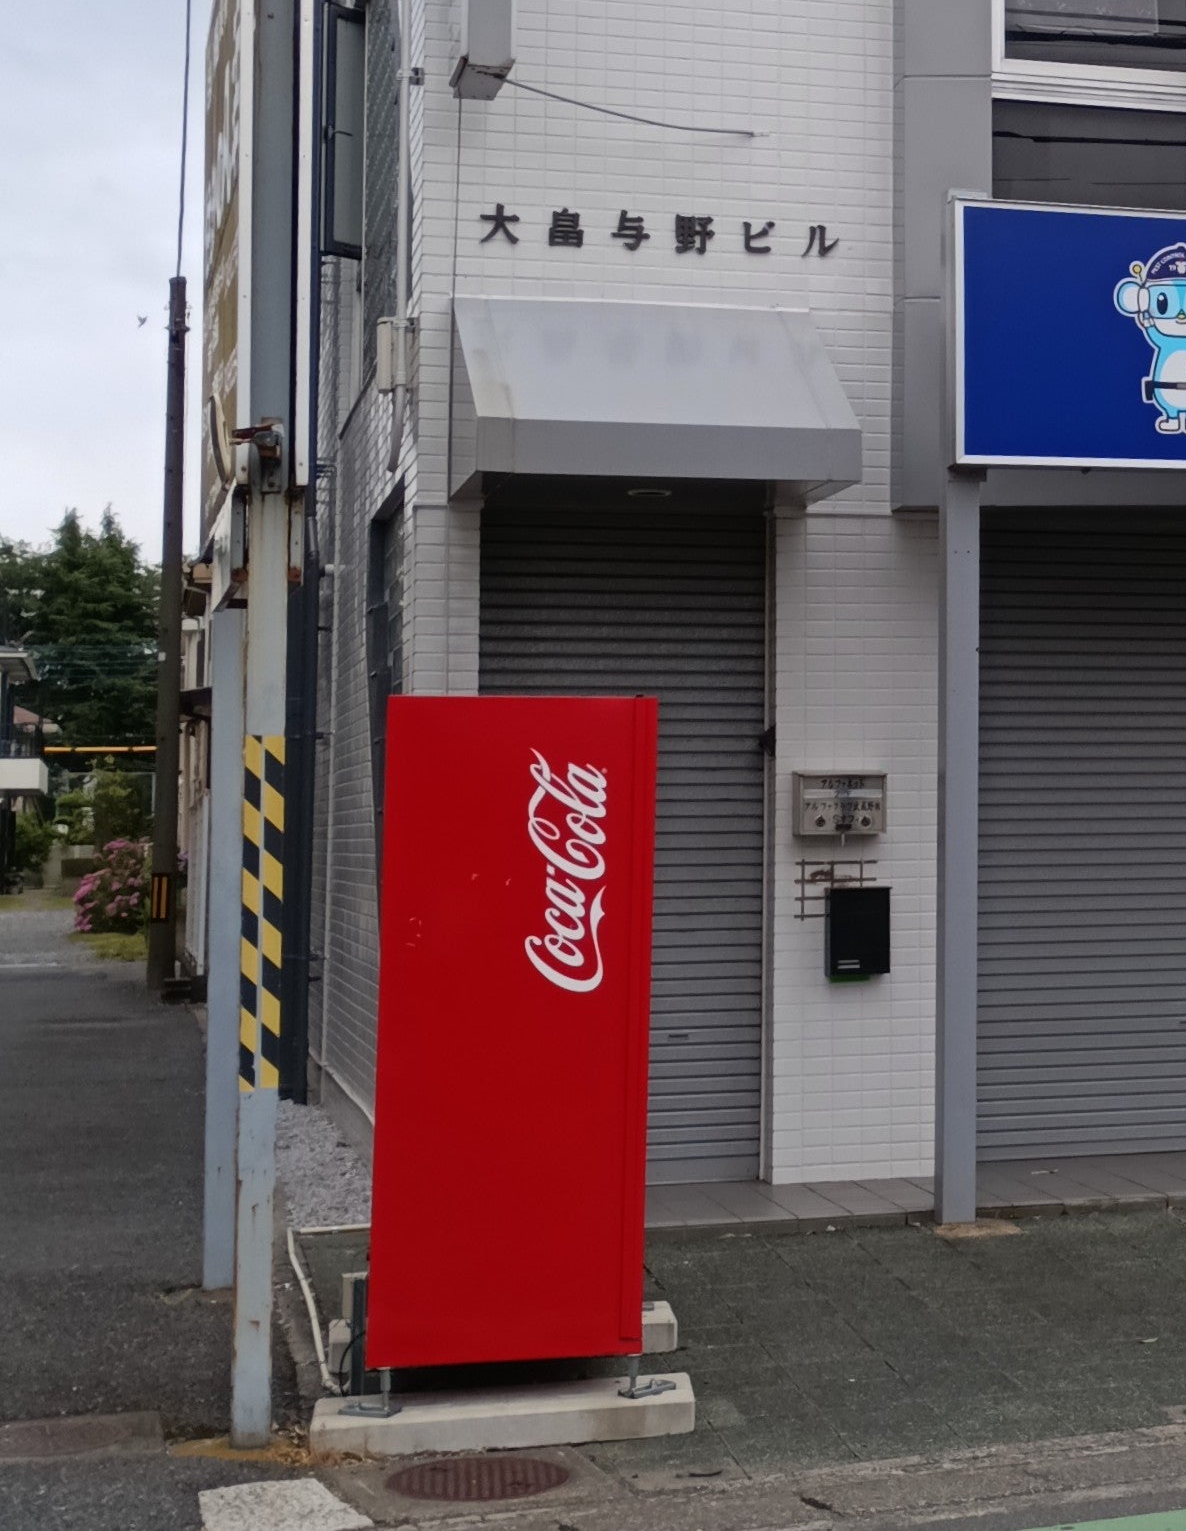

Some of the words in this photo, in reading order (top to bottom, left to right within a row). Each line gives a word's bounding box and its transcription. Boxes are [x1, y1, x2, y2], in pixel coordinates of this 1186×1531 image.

[479, 203, 840, 258] 大畠与野ビル
